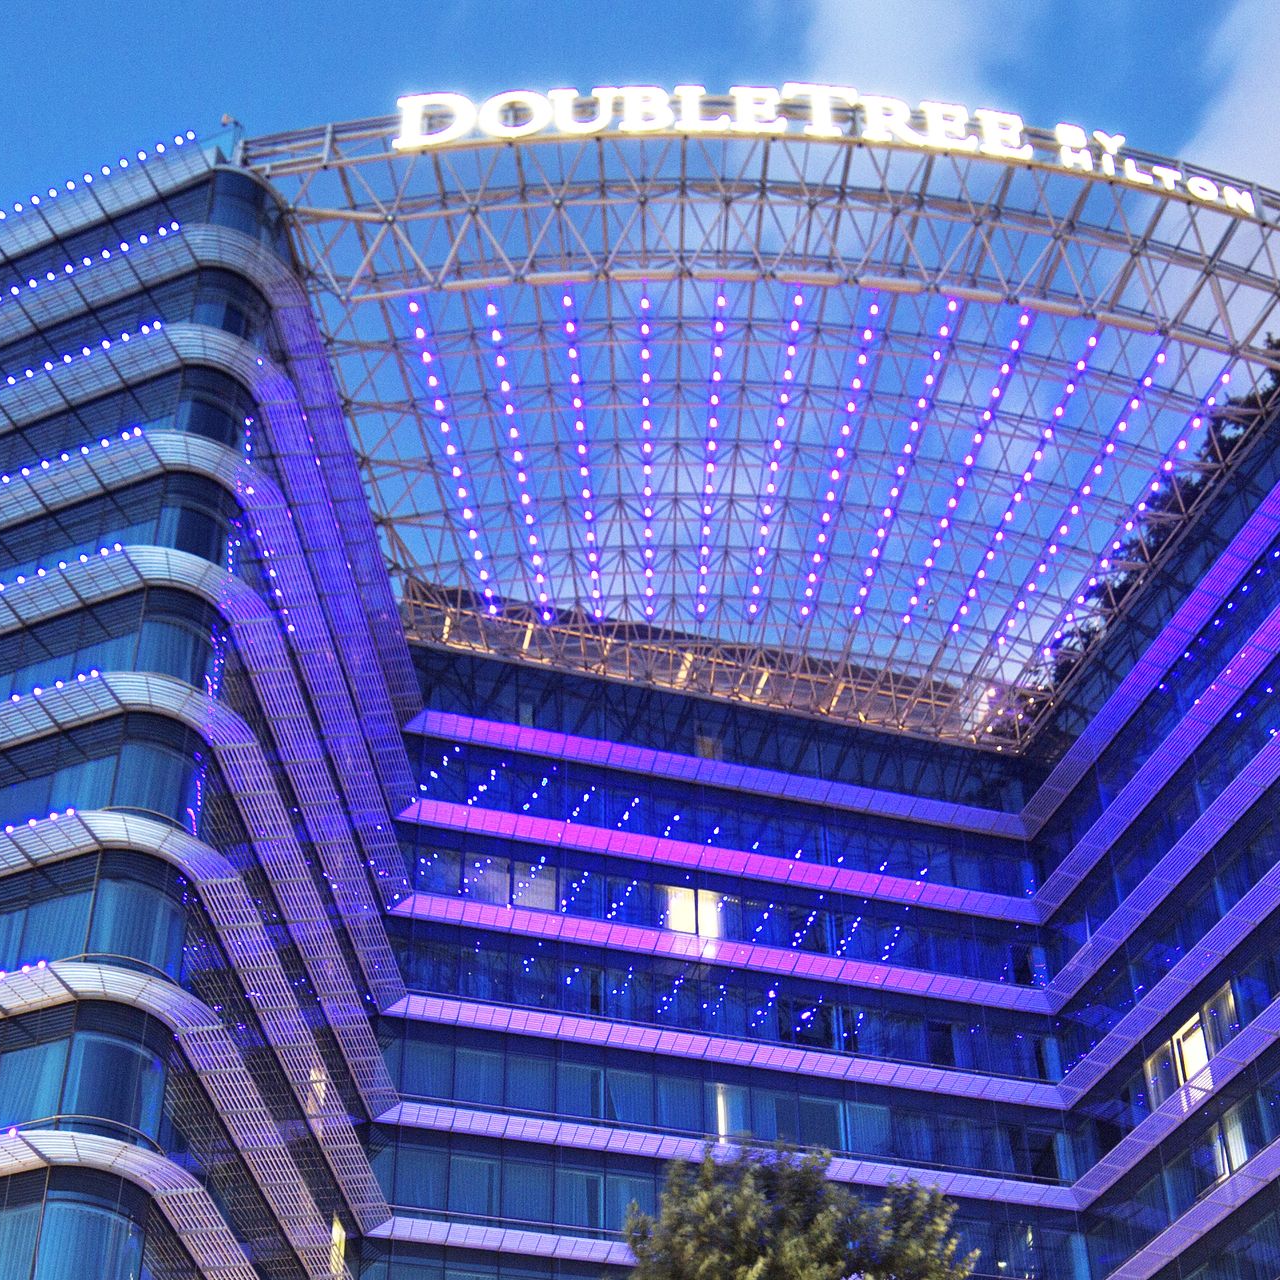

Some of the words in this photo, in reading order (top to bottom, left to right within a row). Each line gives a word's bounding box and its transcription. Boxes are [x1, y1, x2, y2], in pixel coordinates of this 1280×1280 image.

[392, 82, 1033, 160] DOUBLETREE
[1055, 122, 1126, 155] BY
[1060, 145, 1256, 216] HILTON
